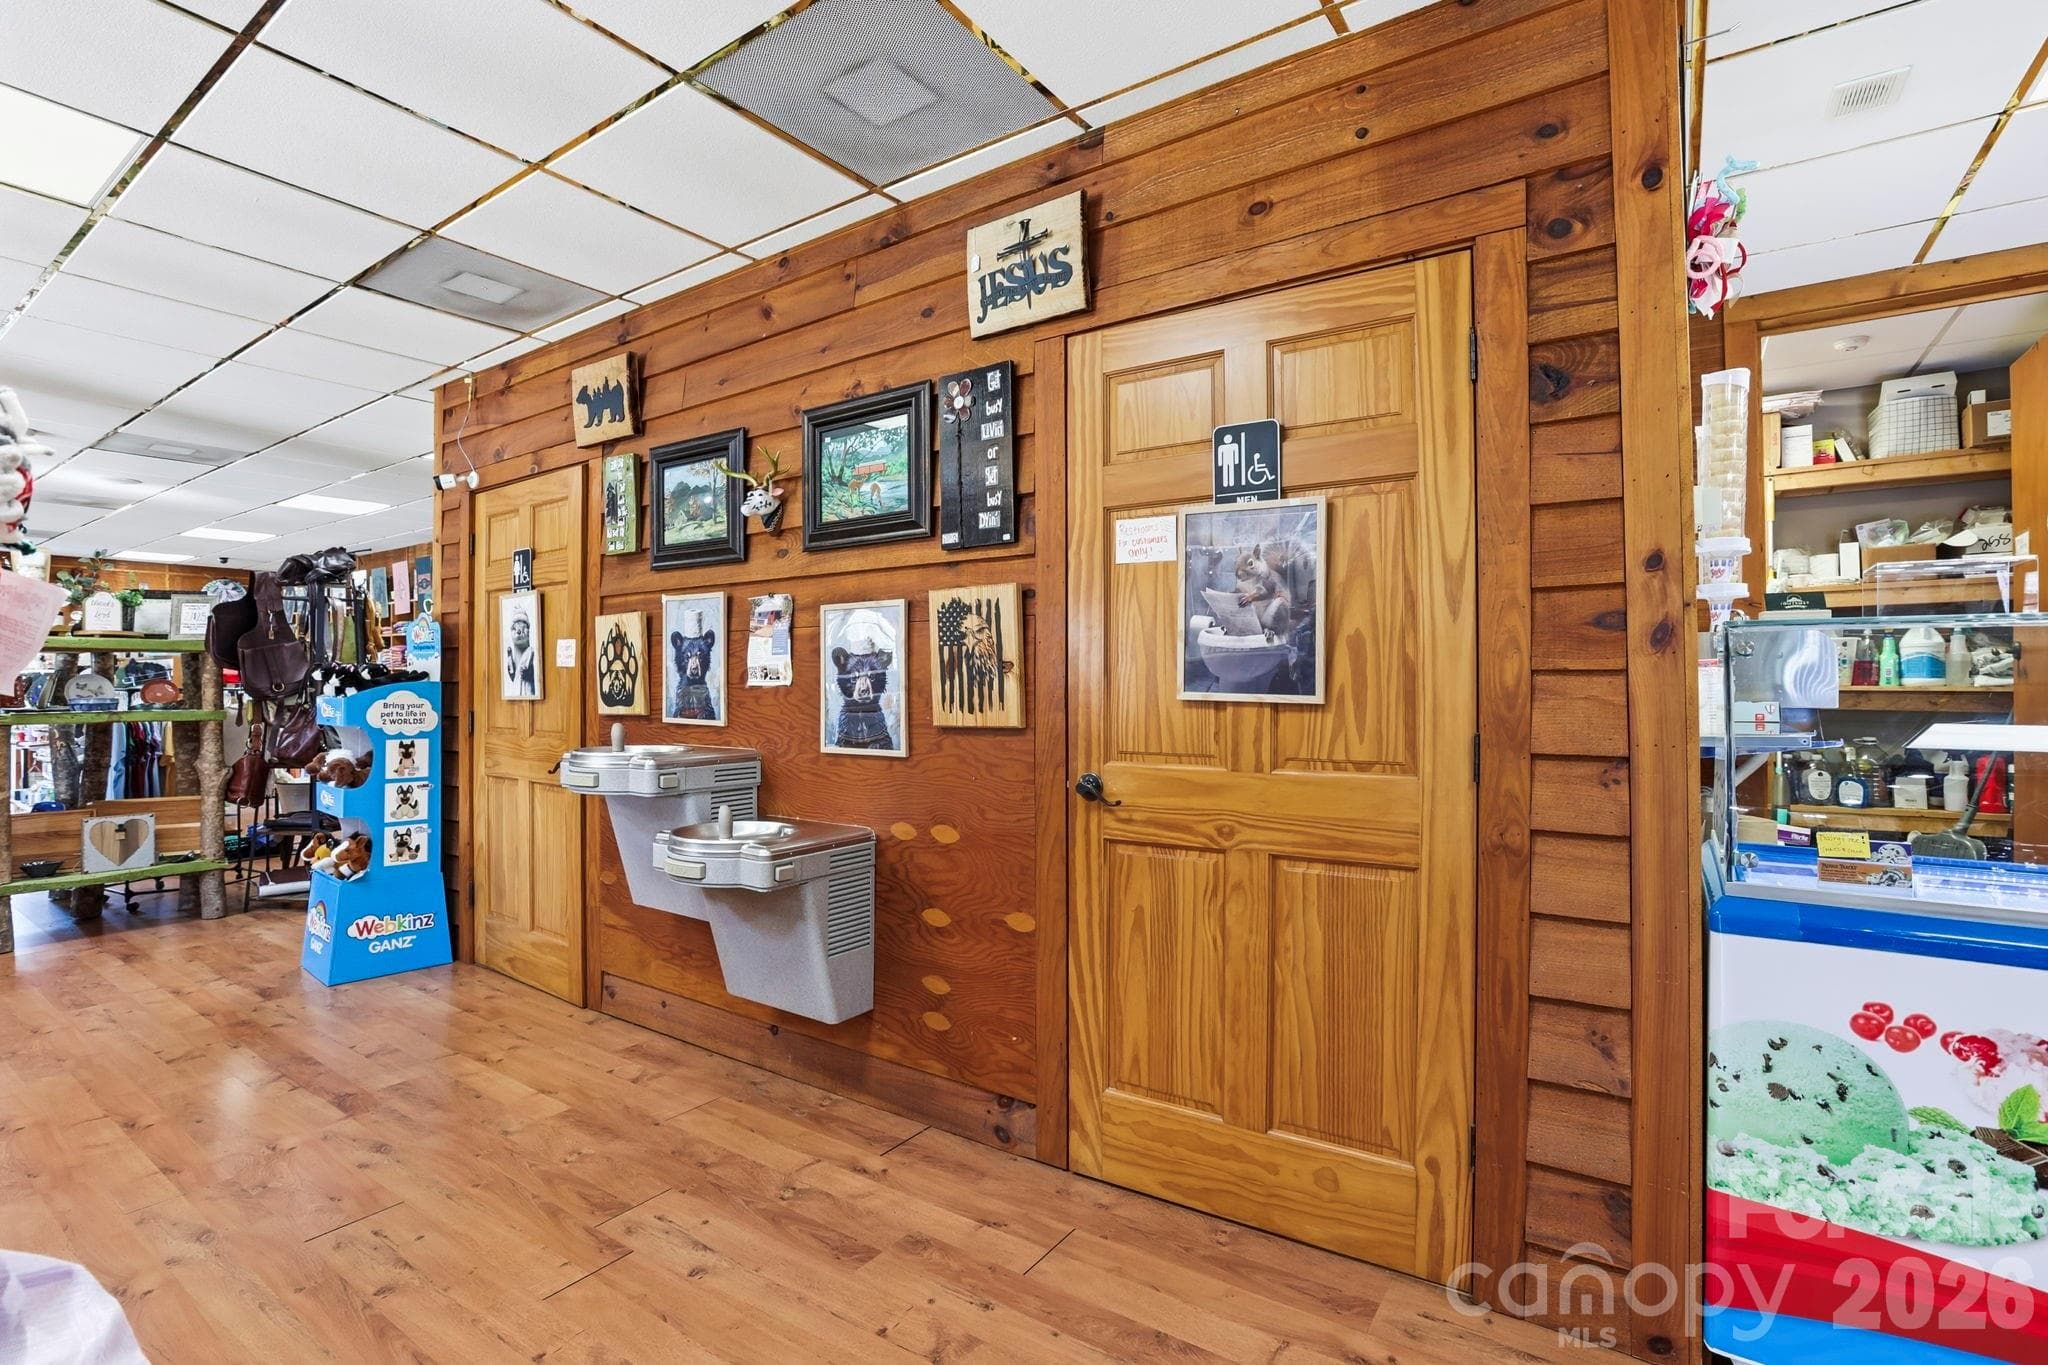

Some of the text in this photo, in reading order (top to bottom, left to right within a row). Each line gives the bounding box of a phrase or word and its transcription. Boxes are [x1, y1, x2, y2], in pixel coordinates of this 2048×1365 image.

[977, 245, 1073, 324] JESUS
[988, 447, 999, 459] or
[1237, 495, 1258, 503] MEN
[383, 702, 405, 710] Bring
[355, 914, 433, 937] Webkinz
[368, 936, 415, 953] GANZ
